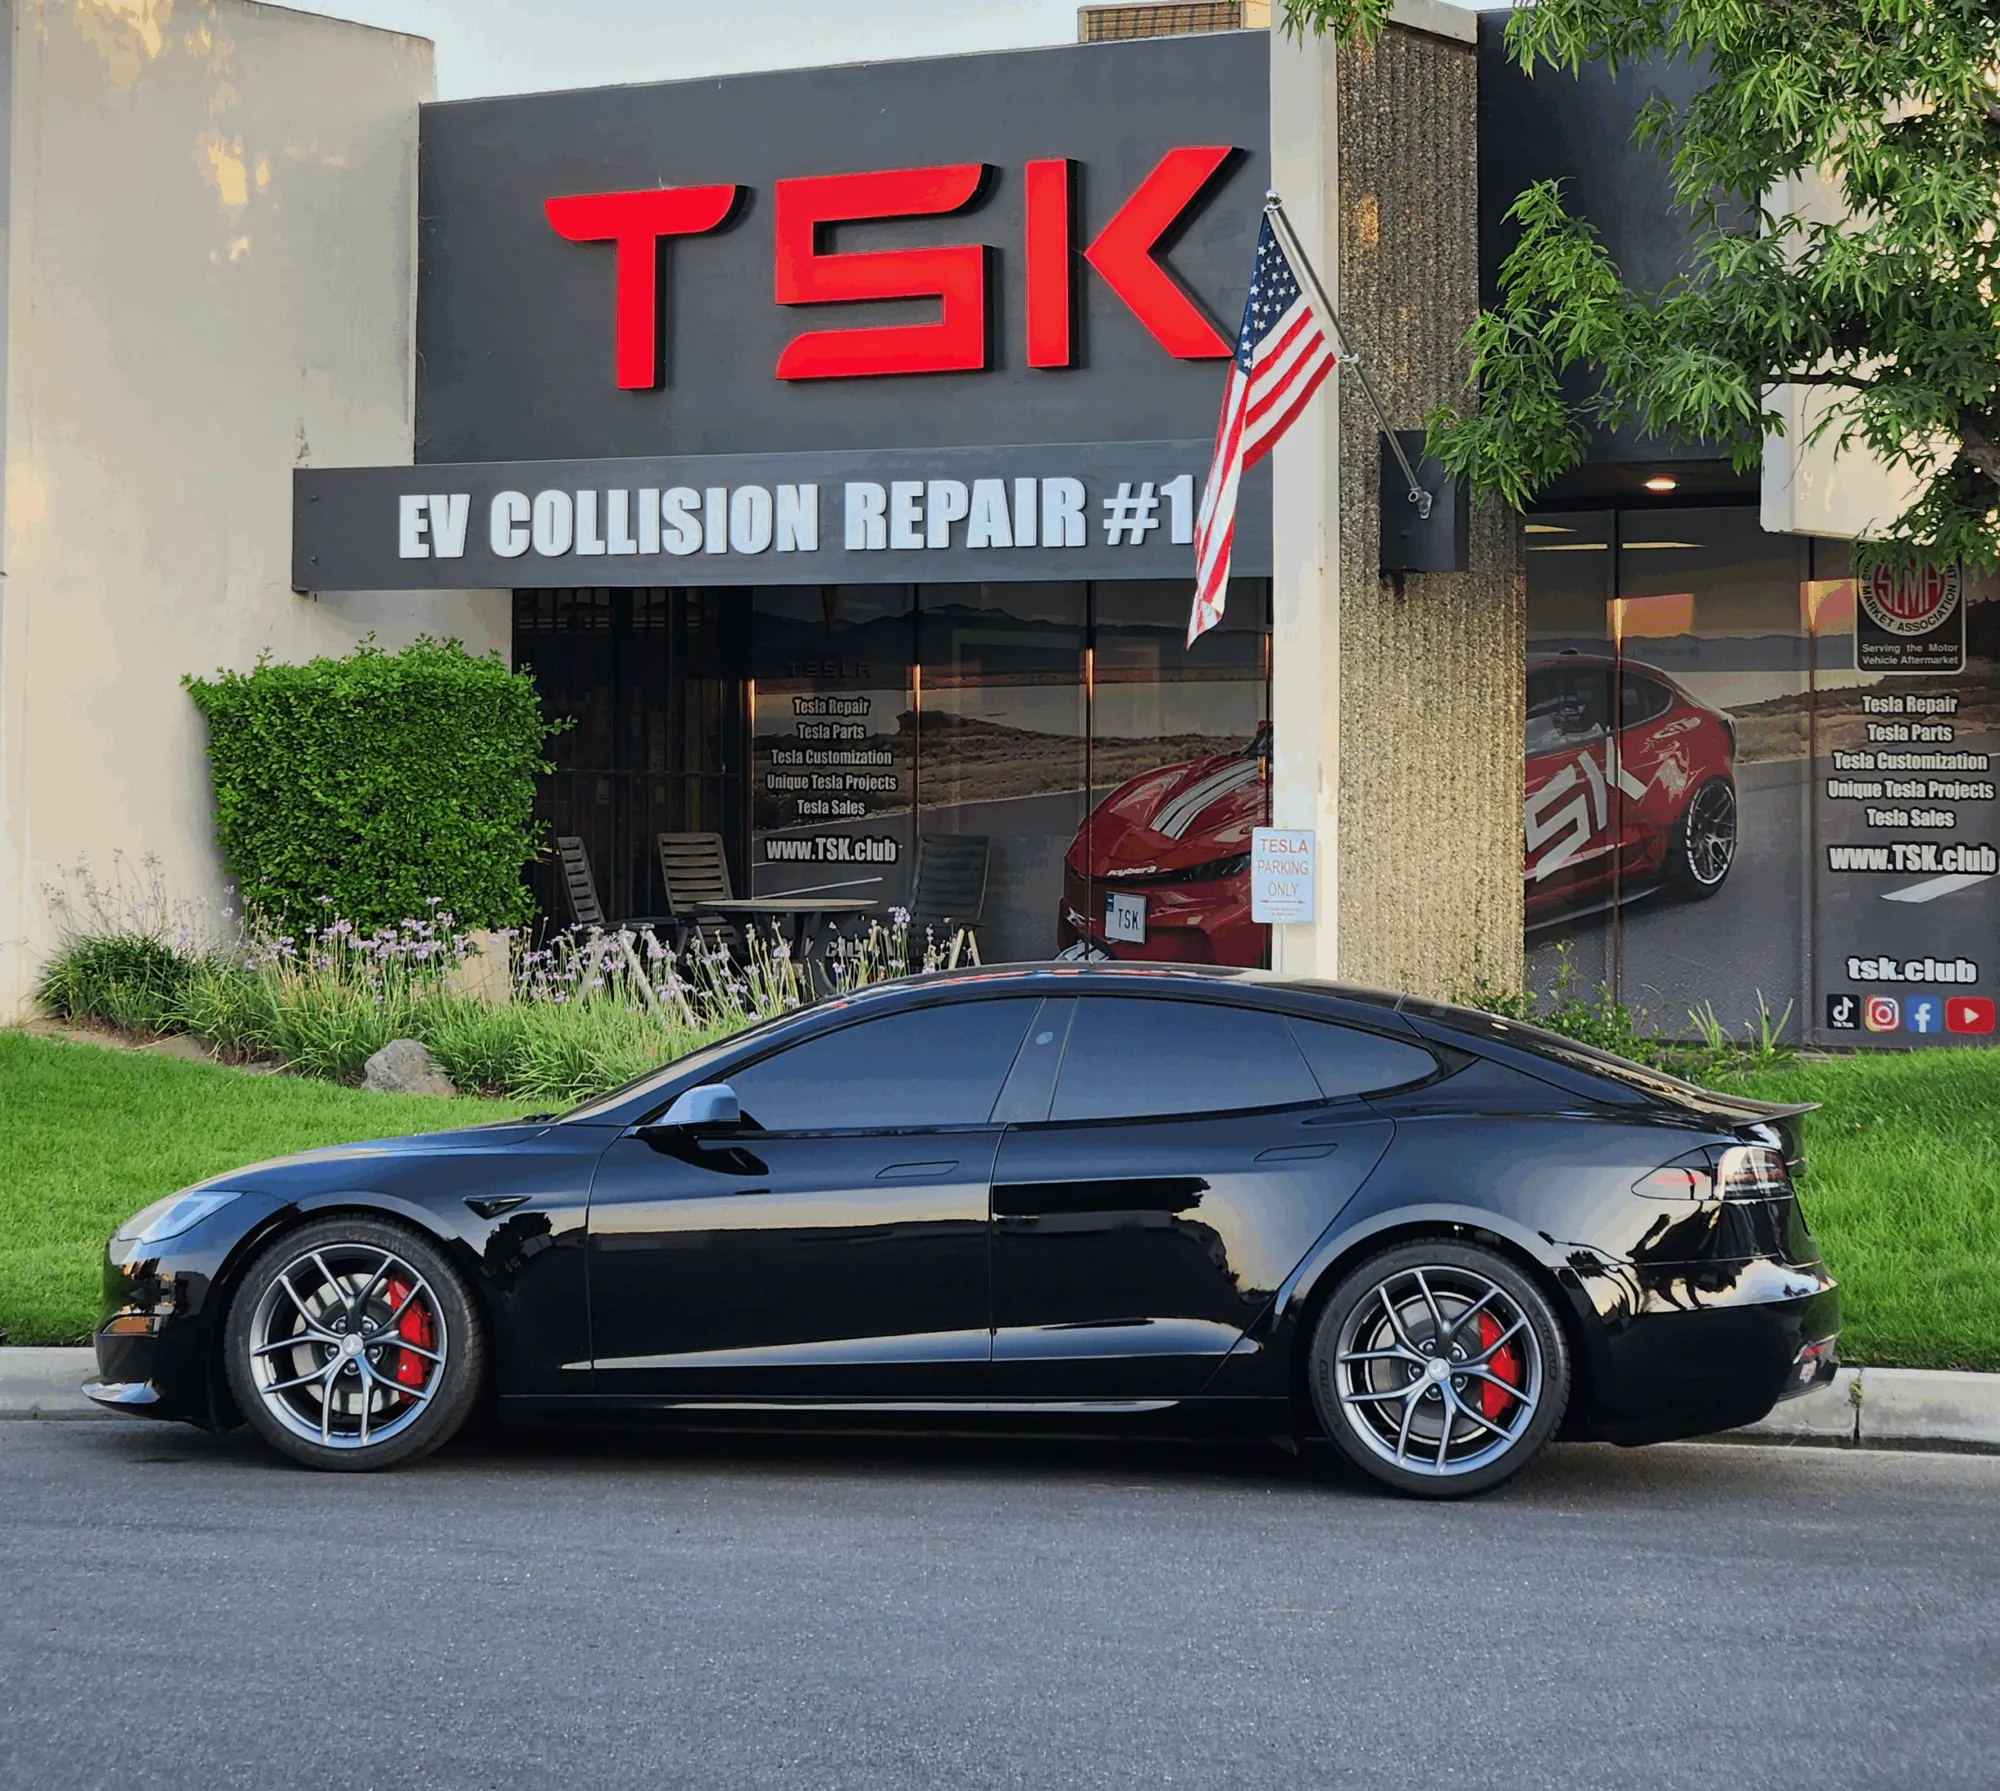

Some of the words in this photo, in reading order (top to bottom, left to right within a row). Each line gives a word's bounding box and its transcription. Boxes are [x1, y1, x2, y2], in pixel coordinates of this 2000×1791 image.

[545, 146, 1243, 390] TSK
[399, 493, 470, 559] EV
[490, 483, 819, 559] COLLISION
[844, 476, 1087, 550] REPAIR
[1103, 474, 1195, 546] #1
[1861, 586, 1895, 628] MARKET
[1896, 585, 1958, 633] ASSOCIATION
[1862, 644, 1901, 655] Serving
[1906, 644, 1923, 653] the
[1928, 644, 1959, 653] Motor
[1862, 656, 1898, 665] Vehicle
[1900, 656, 1959, 665] Aftermarket
[794, 699, 826, 714] Tesla
[829, 699, 870, 716] Repair
[1863, 696, 1903, 713] Tesla
[1906, 696, 1958, 715] Repair
[798, 724, 830, 739] Tesla
[832, 724, 865, 739] Parts
[1867, 724, 1908, 741] Tesla
[1911, 724, 1953, 741] Parts
[772, 749, 803, 764] Tesla
[805, 749, 892, 765] Customization
[1833, 752, 1874, 769] Tesla
[1877, 752, 1988, 770] Customization
[767, 774, 809, 790] Unique
[811, 774, 843, 789] Tesla
[845, 774, 897, 791] Projects
[1828, 780, 1882, 800] Unique
[1884, 780, 1926, 797] Tesla
[1928, 780, 1995, 801] Projects
[797, 799, 829, 814] Tesla
[831, 799, 866, 815] Sales
[1866, 809, 1908, 826] Tesla
[1910, 809, 1955, 827] Sales
[766, 837, 896, 861] www.TSK.club
[1260, 838, 1309, 854] TESLA
[1829, 843, 1997, 872] www.TSK.club
[1257, 860, 1309, 876] PARKING
[1267, 881, 1299, 897] ONLY
[1117, 908, 1140, 931] TSK
[1847, 957, 1977, 983] tsk.club
